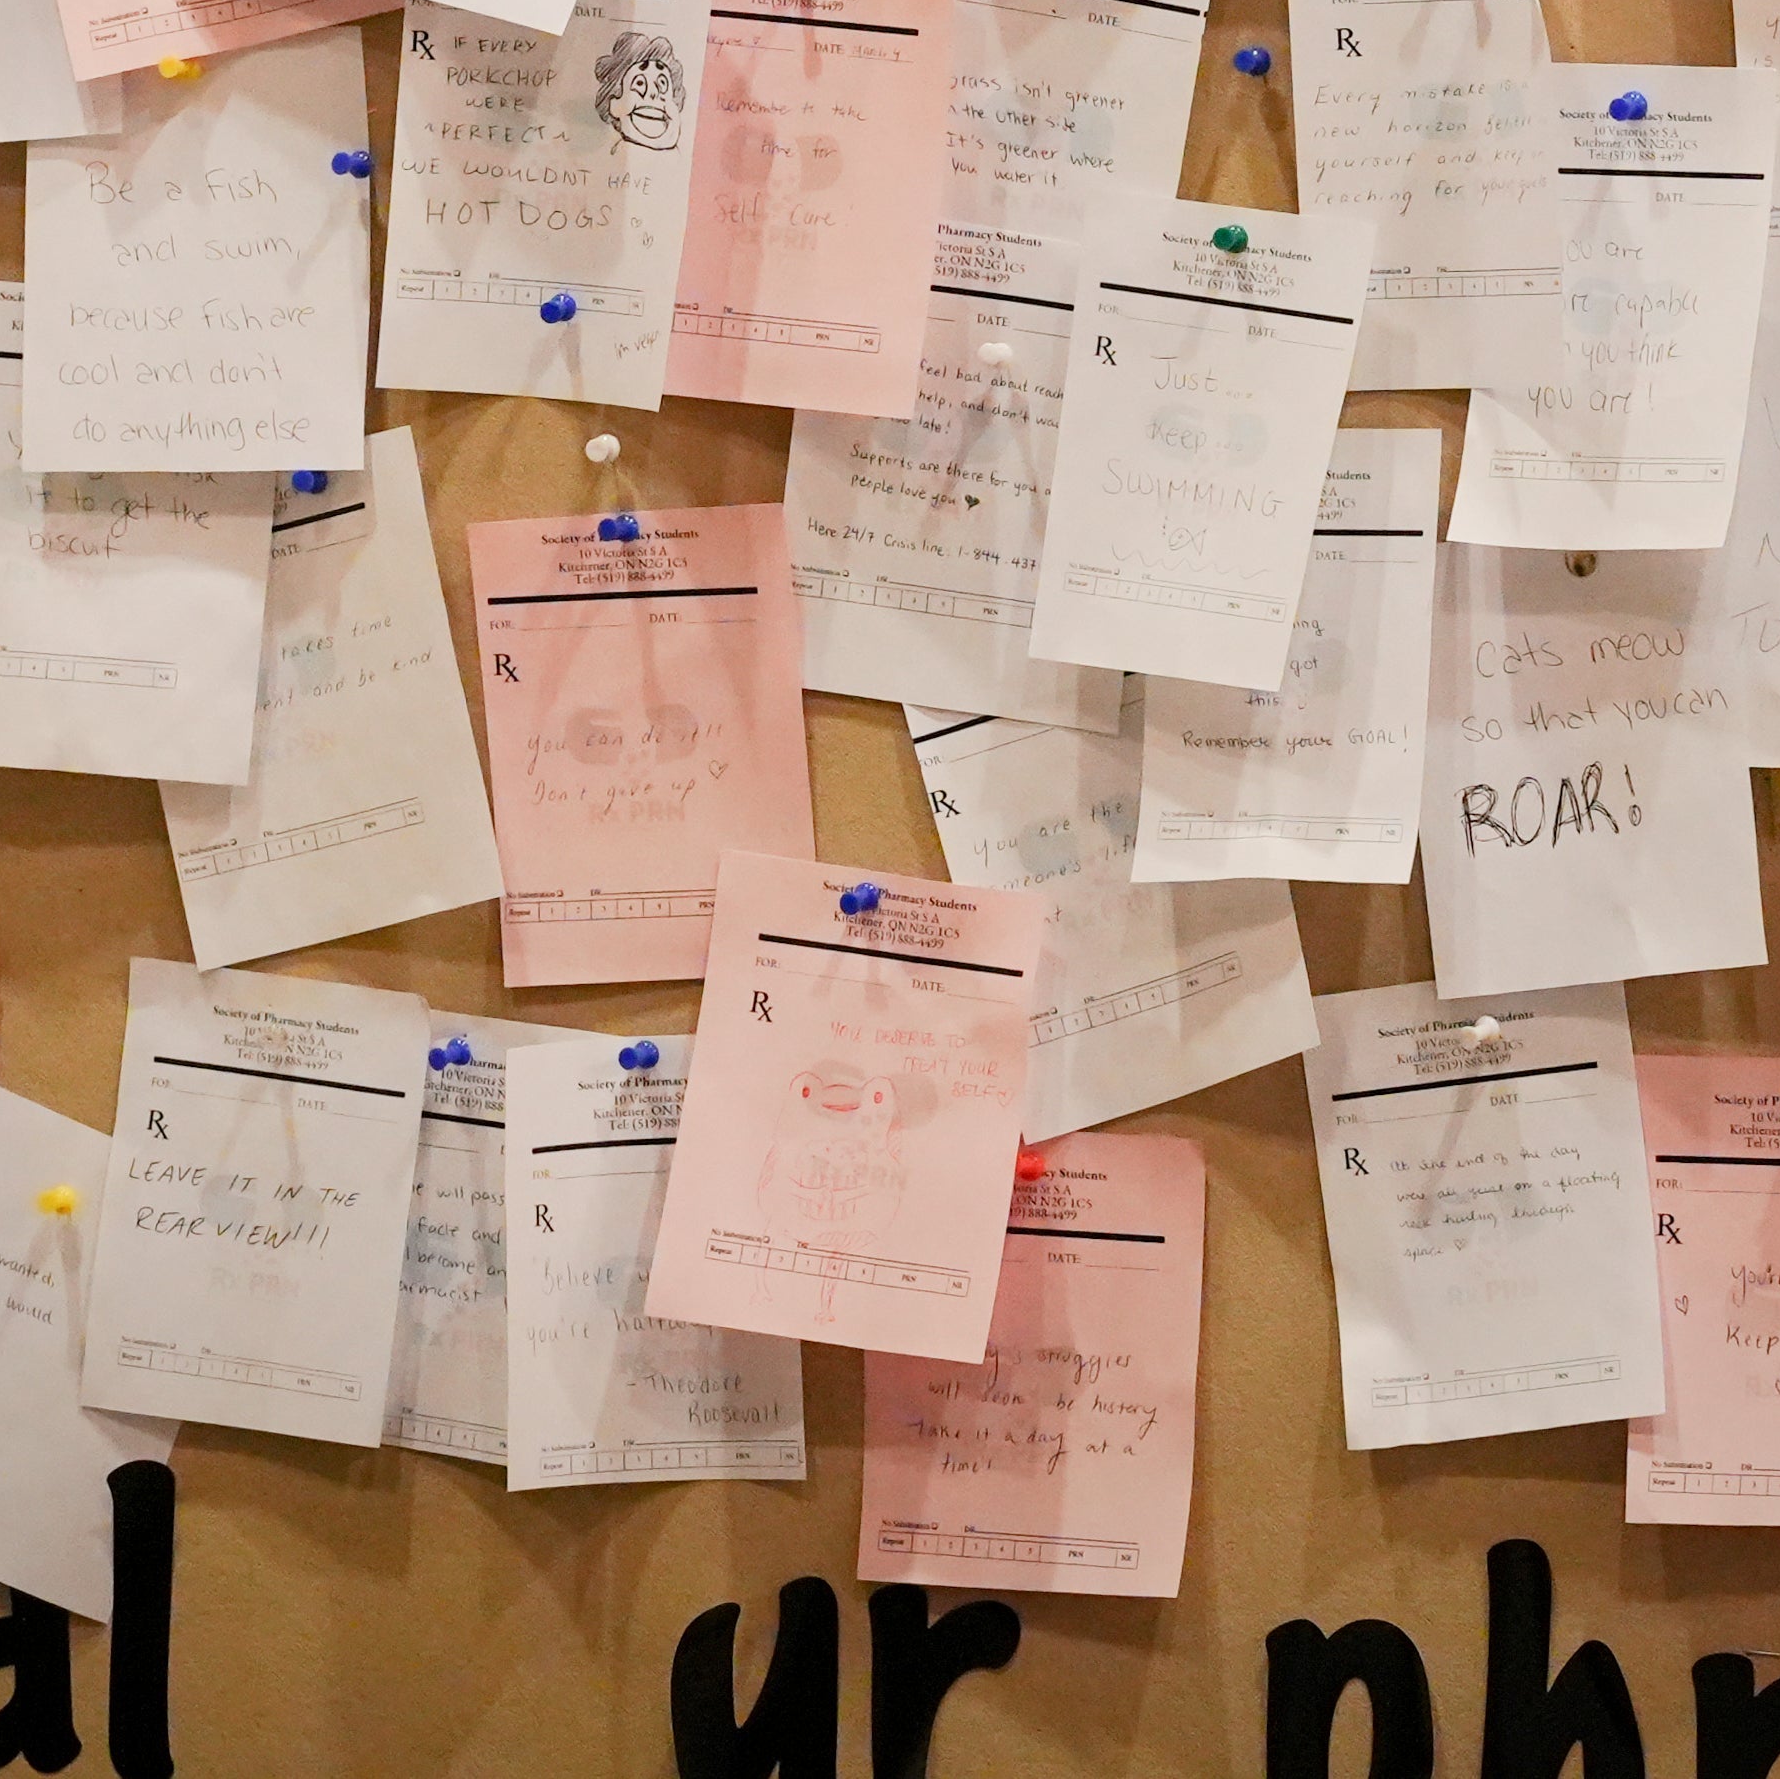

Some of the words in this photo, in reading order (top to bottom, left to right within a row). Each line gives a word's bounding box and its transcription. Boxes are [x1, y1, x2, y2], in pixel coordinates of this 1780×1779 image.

[454, 37, 468, 49] IF
[478, 39, 537, 52] EVERY
[446, 67, 557, 87] PORKCHOP
[465, 97, 524, 112] WERE
[85, 160, 134, 204] Be
[165, 181, 181, 201] a
[402, 158, 440, 175] WE
[607, 171, 652, 195] HAVE
[426, 198, 499, 225] HOT
[519, 201, 612, 231] DOGS
[111, 234, 177, 266] and
[70, 302, 183, 331] because
[271, 306, 316, 328] are
[59, 354, 119, 386] cool
[135, 358, 193, 384] and
[209, 352, 282, 384] don't
[73, 412, 106, 442] do
[121, 412, 246, 451] anything
[255, 408, 310, 442] else
[1590, 628, 1685, 663] meow
[1524, 696, 1598, 731] that
[1673, 688, 1728, 715] can
[1454, 760, 1642, 858] ROAR!
[129, 1158, 208, 1186] LEAVE
[229, 1175, 257, 1192] IT
[274, 1185, 304, 1200] IN
[320, 1188, 360, 1207] THE
[136, 1206, 205, 1238] REAR
[6, 1297, 53, 1325] would
[1726, 1324, 1780, 1354] Keep
